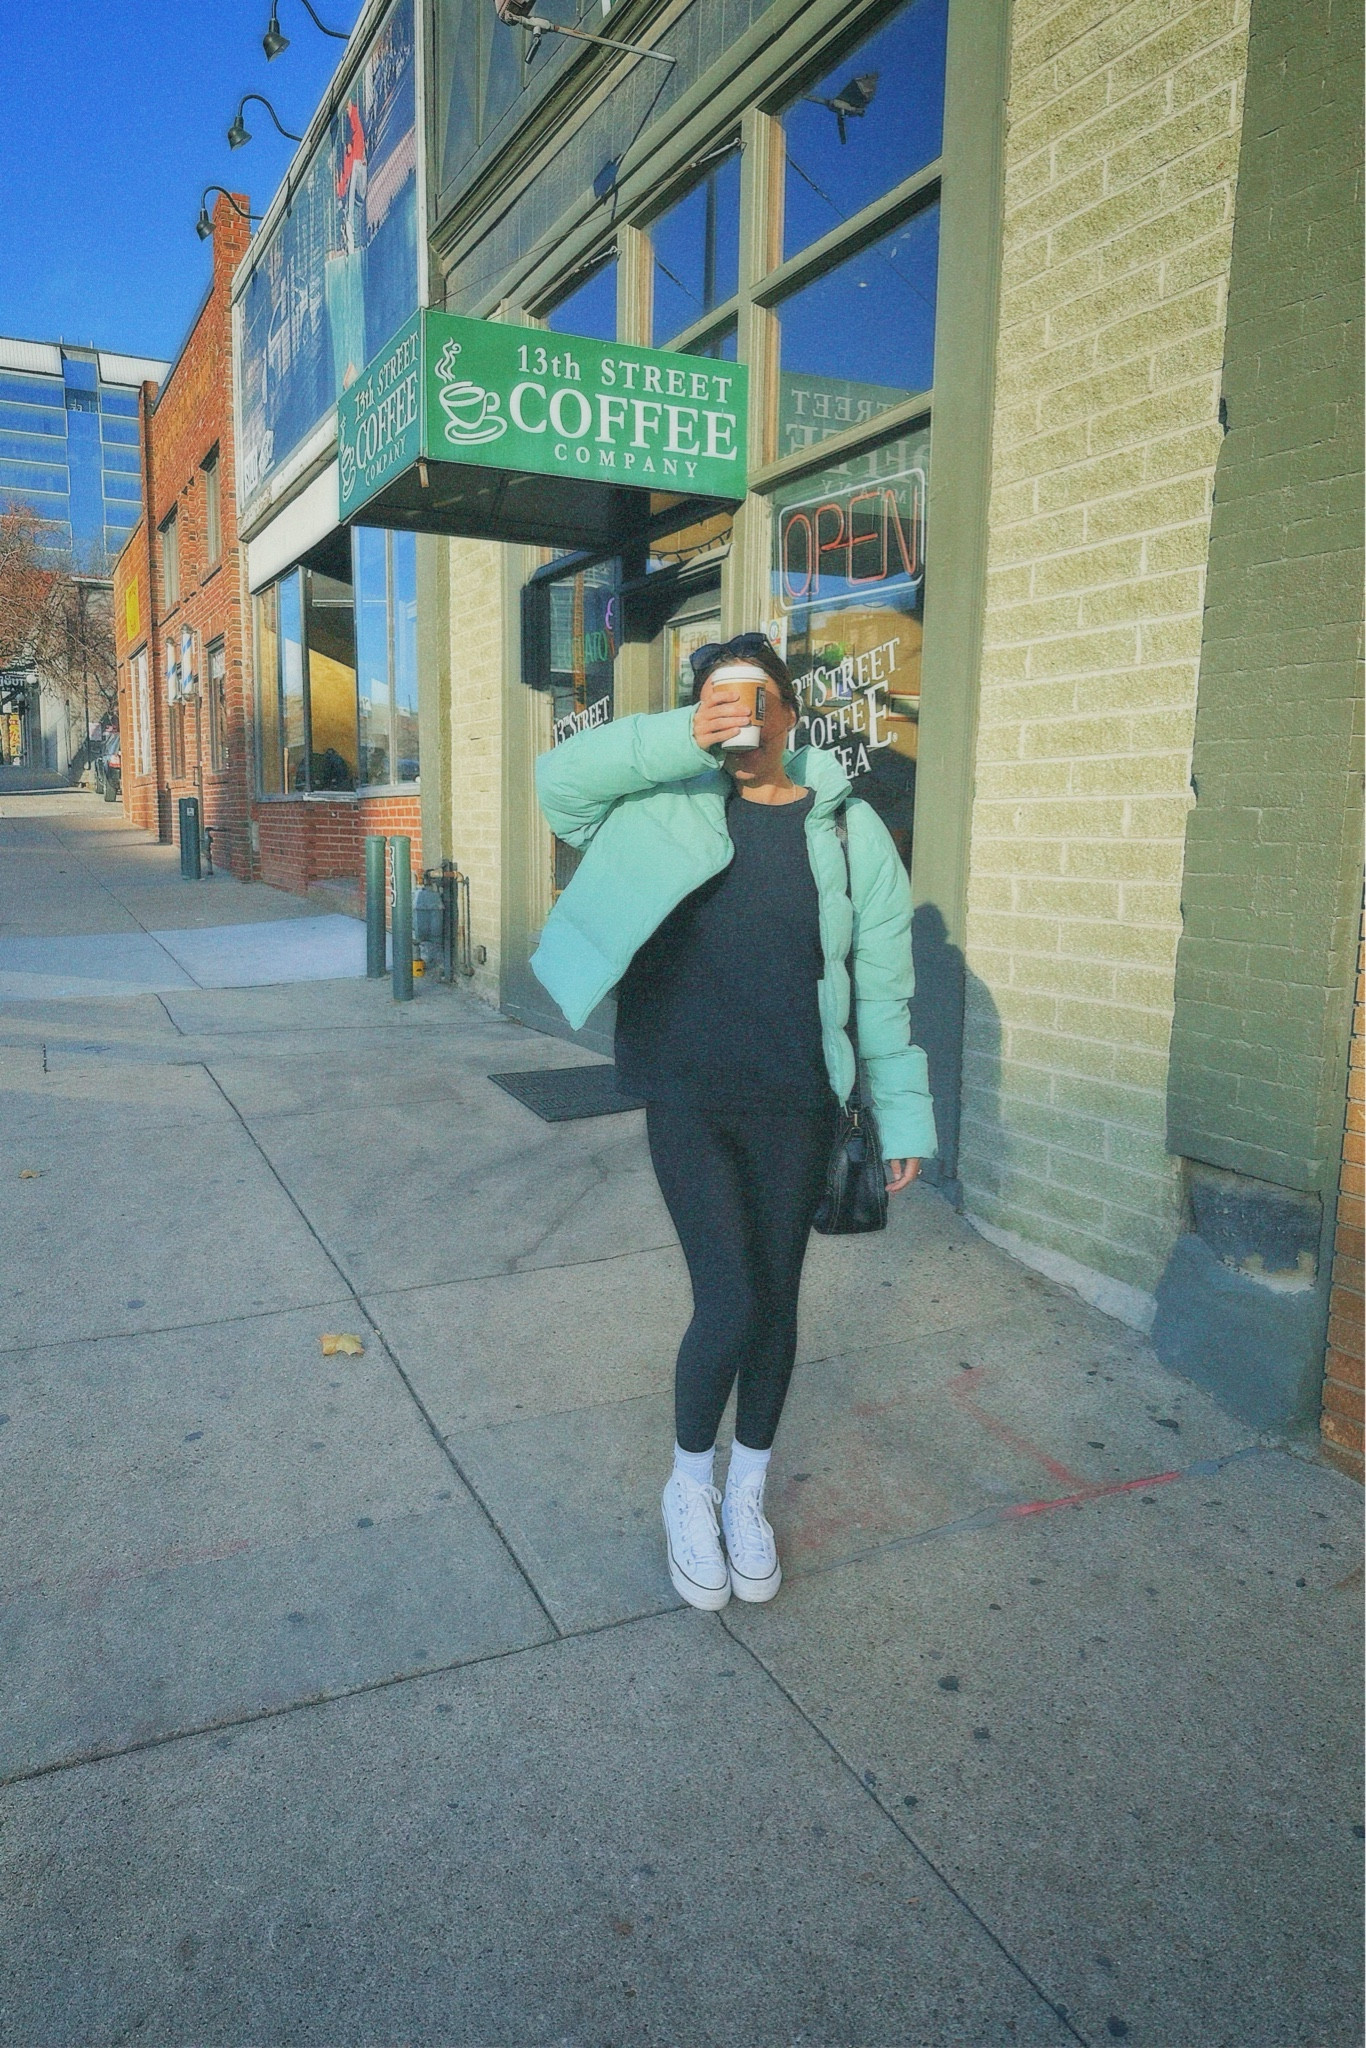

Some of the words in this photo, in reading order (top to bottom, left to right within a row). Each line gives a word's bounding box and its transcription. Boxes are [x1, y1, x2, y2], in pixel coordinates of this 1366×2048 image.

[355, 375, 375, 425] 13th
[377, 331, 419, 396] STREET
[517, 344, 582, 381] 13th
[600, 358, 732, 404] STREET
[356, 370, 418, 470] COFFEE
[508, 381, 738, 461] COFFEE
[365, 434, 406, 486] COMPANY
[554, 443, 698, 479] COMPANY
[784, 486, 918, 597] OPEN
[814, 637, 900, 707] STREET
